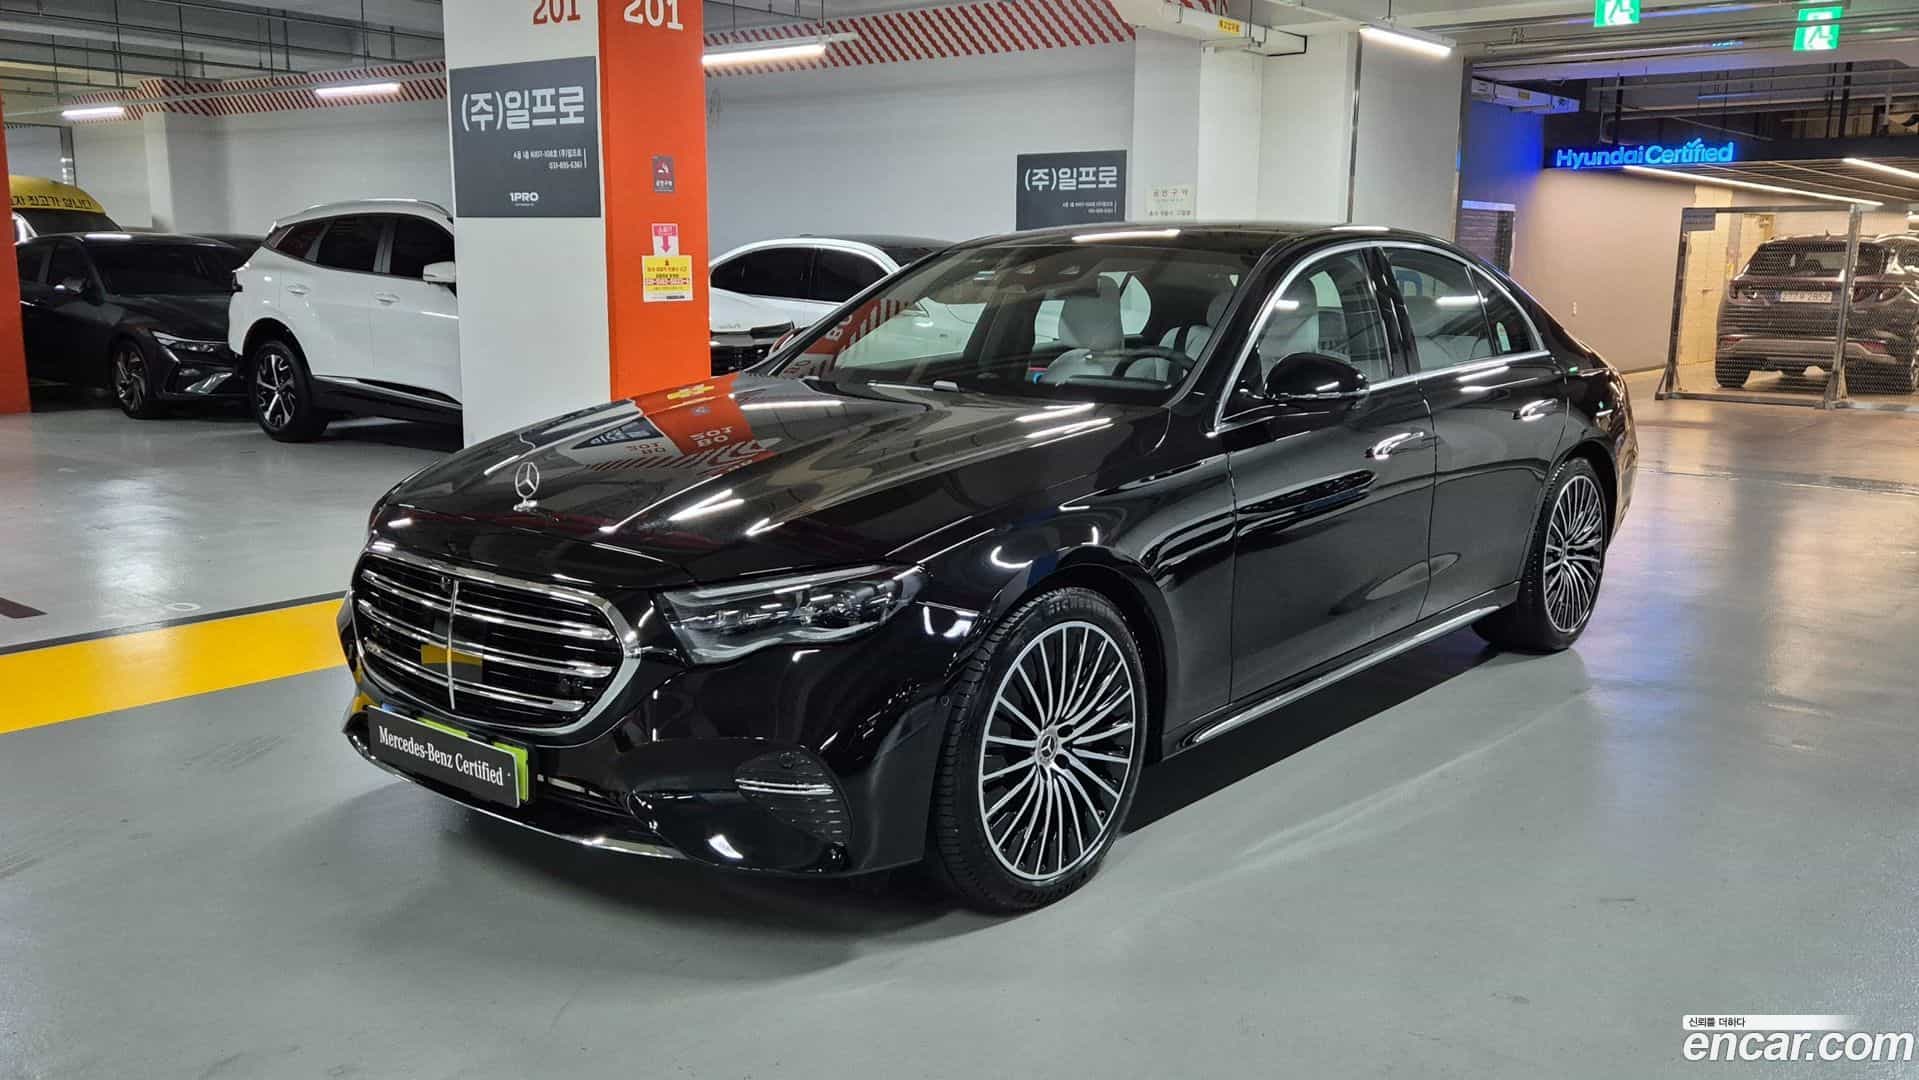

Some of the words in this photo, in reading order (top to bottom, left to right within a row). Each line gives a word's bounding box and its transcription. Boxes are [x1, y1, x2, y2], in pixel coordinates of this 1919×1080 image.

[533, 0, 580, 24] 201
[624, 0, 683, 30] 201
[461, 86, 585, 132] (주)일프로
[1556, 145, 1644, 170] Hyundai
[1645, 138, 1734, 164] Certified
[1025, 166, 1118, 191] (주)일프로
[509, 192, 539, 202] 1PRO
[378, 725, 454, 769] Mercedes-Benz
[455, 752, 504, 786] Certified
